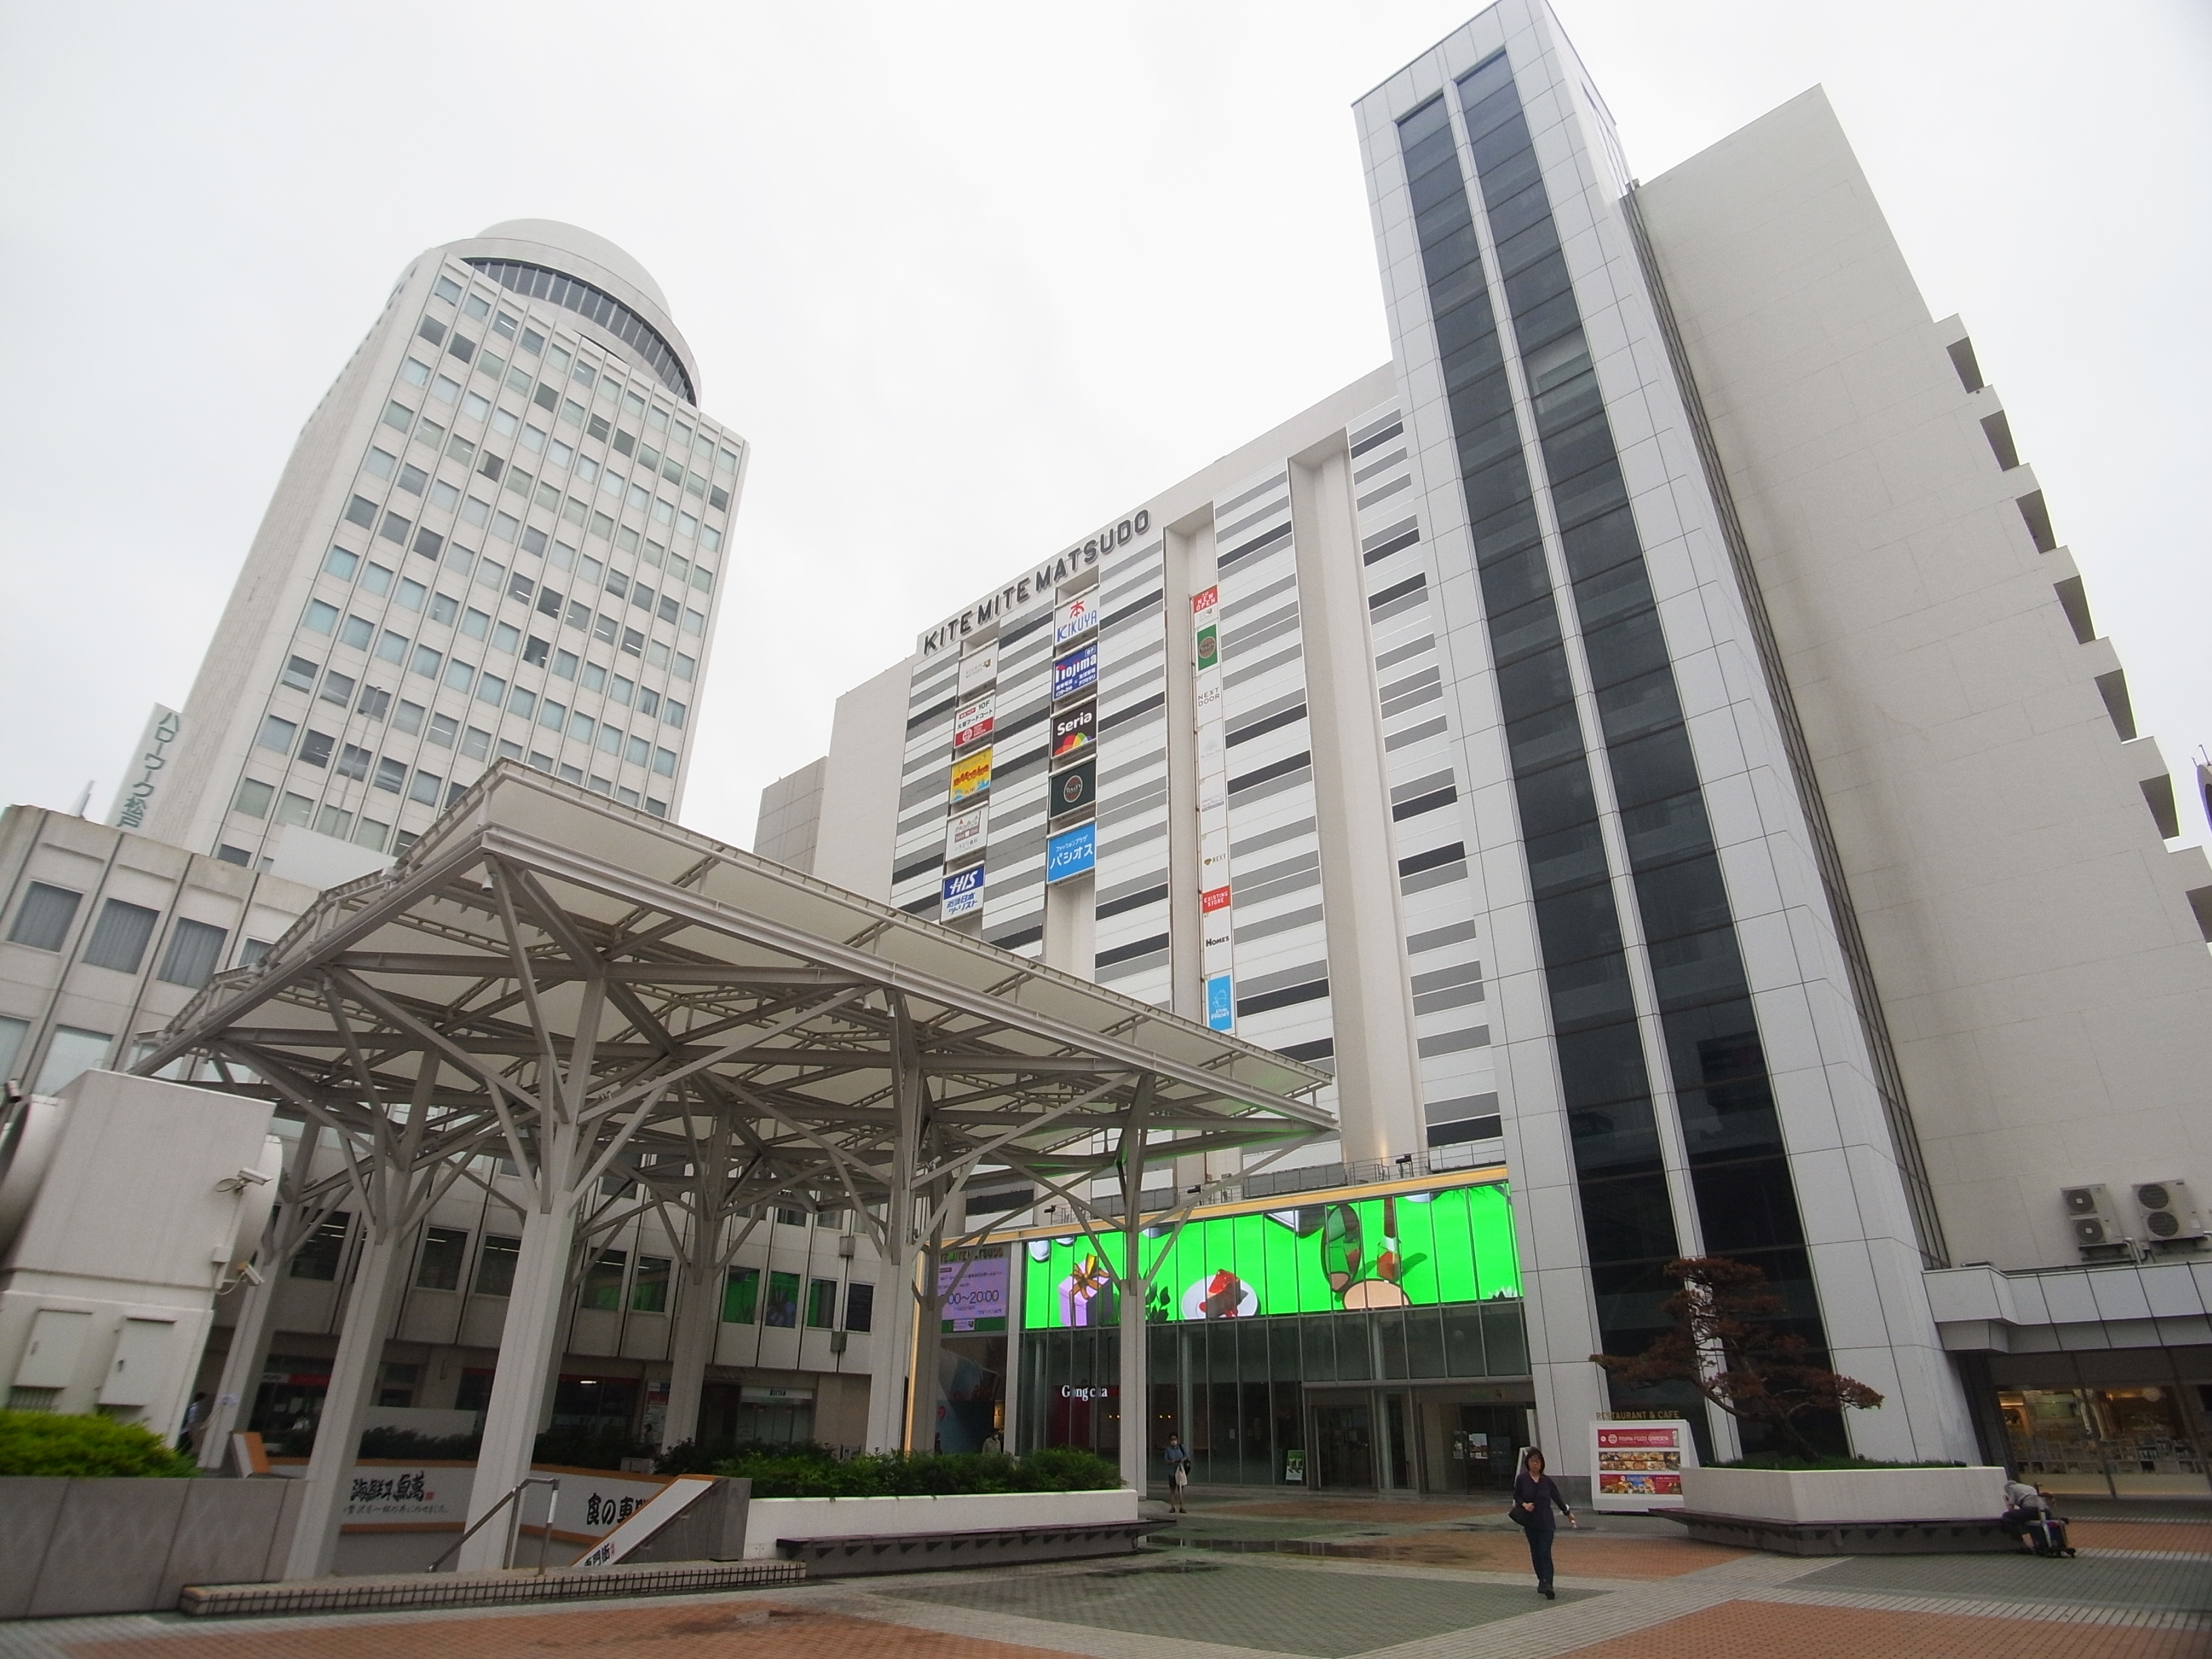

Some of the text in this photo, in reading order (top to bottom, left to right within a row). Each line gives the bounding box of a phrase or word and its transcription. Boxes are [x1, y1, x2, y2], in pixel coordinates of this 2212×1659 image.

[924, 509, 1149, 655] KITE MITE MATSUDO
[1196, 597, 1216, 611] OPEN
[1057, 610, 1097, 642] KIKUYA
[1197, 687, 1219, 701] NEXT
[1198, 693, 1220, 708] DOOR
[1057, 712, 1092, 737] Seria
[116, 712, 180, 829] ハローワーク松戸
[1050, 843, 1093, 870] パシオス
[1204, 890, 1229, 903] EXISTING
[1208, 897, 1225, 907] STORE
[948, 899, 978, 915] ツーリスト
[1596, 1411, 1646, 1420] RESTAURANT
[1658, 1410, 1680, 1419] CAFE
